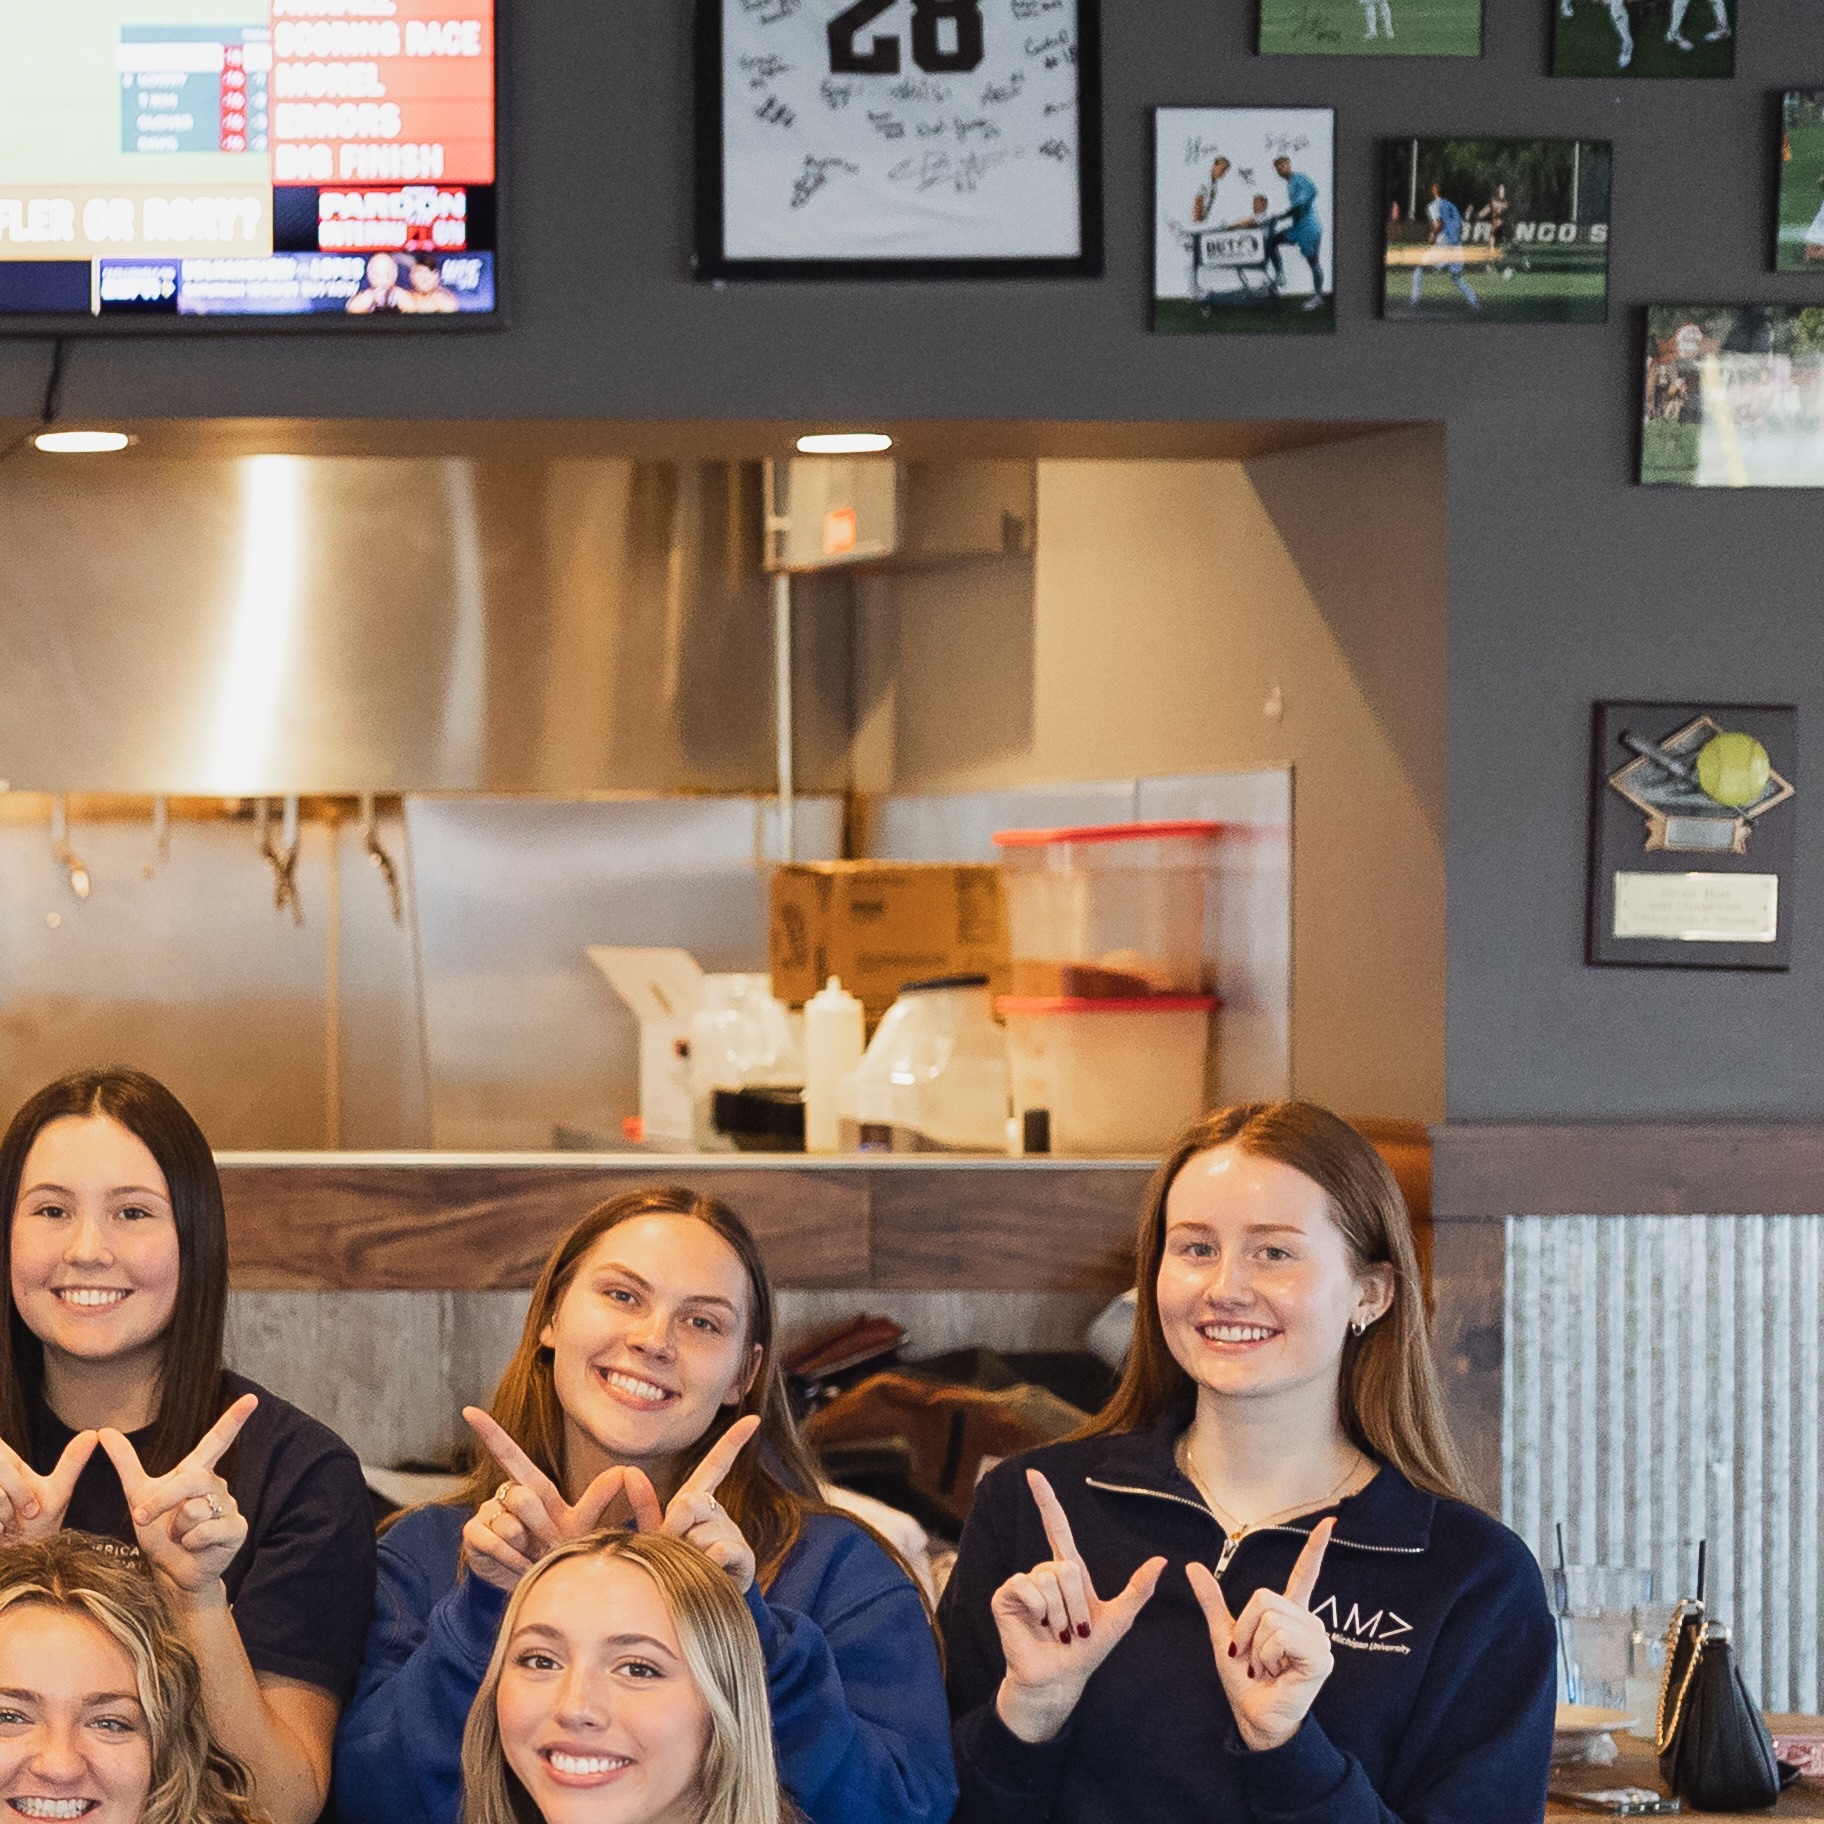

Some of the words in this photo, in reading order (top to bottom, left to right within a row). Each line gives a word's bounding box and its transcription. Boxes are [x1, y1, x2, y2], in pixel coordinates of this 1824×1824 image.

[405, 20, 481, 56] RACE
[274, 143, 333, 181] BIG
[339, 143, 444, 179] FINISH
[84, 198, 135, 241] OR
[144, 196, 262, 241] RORY?
[1460, 222, 1578, 243] RNCO
